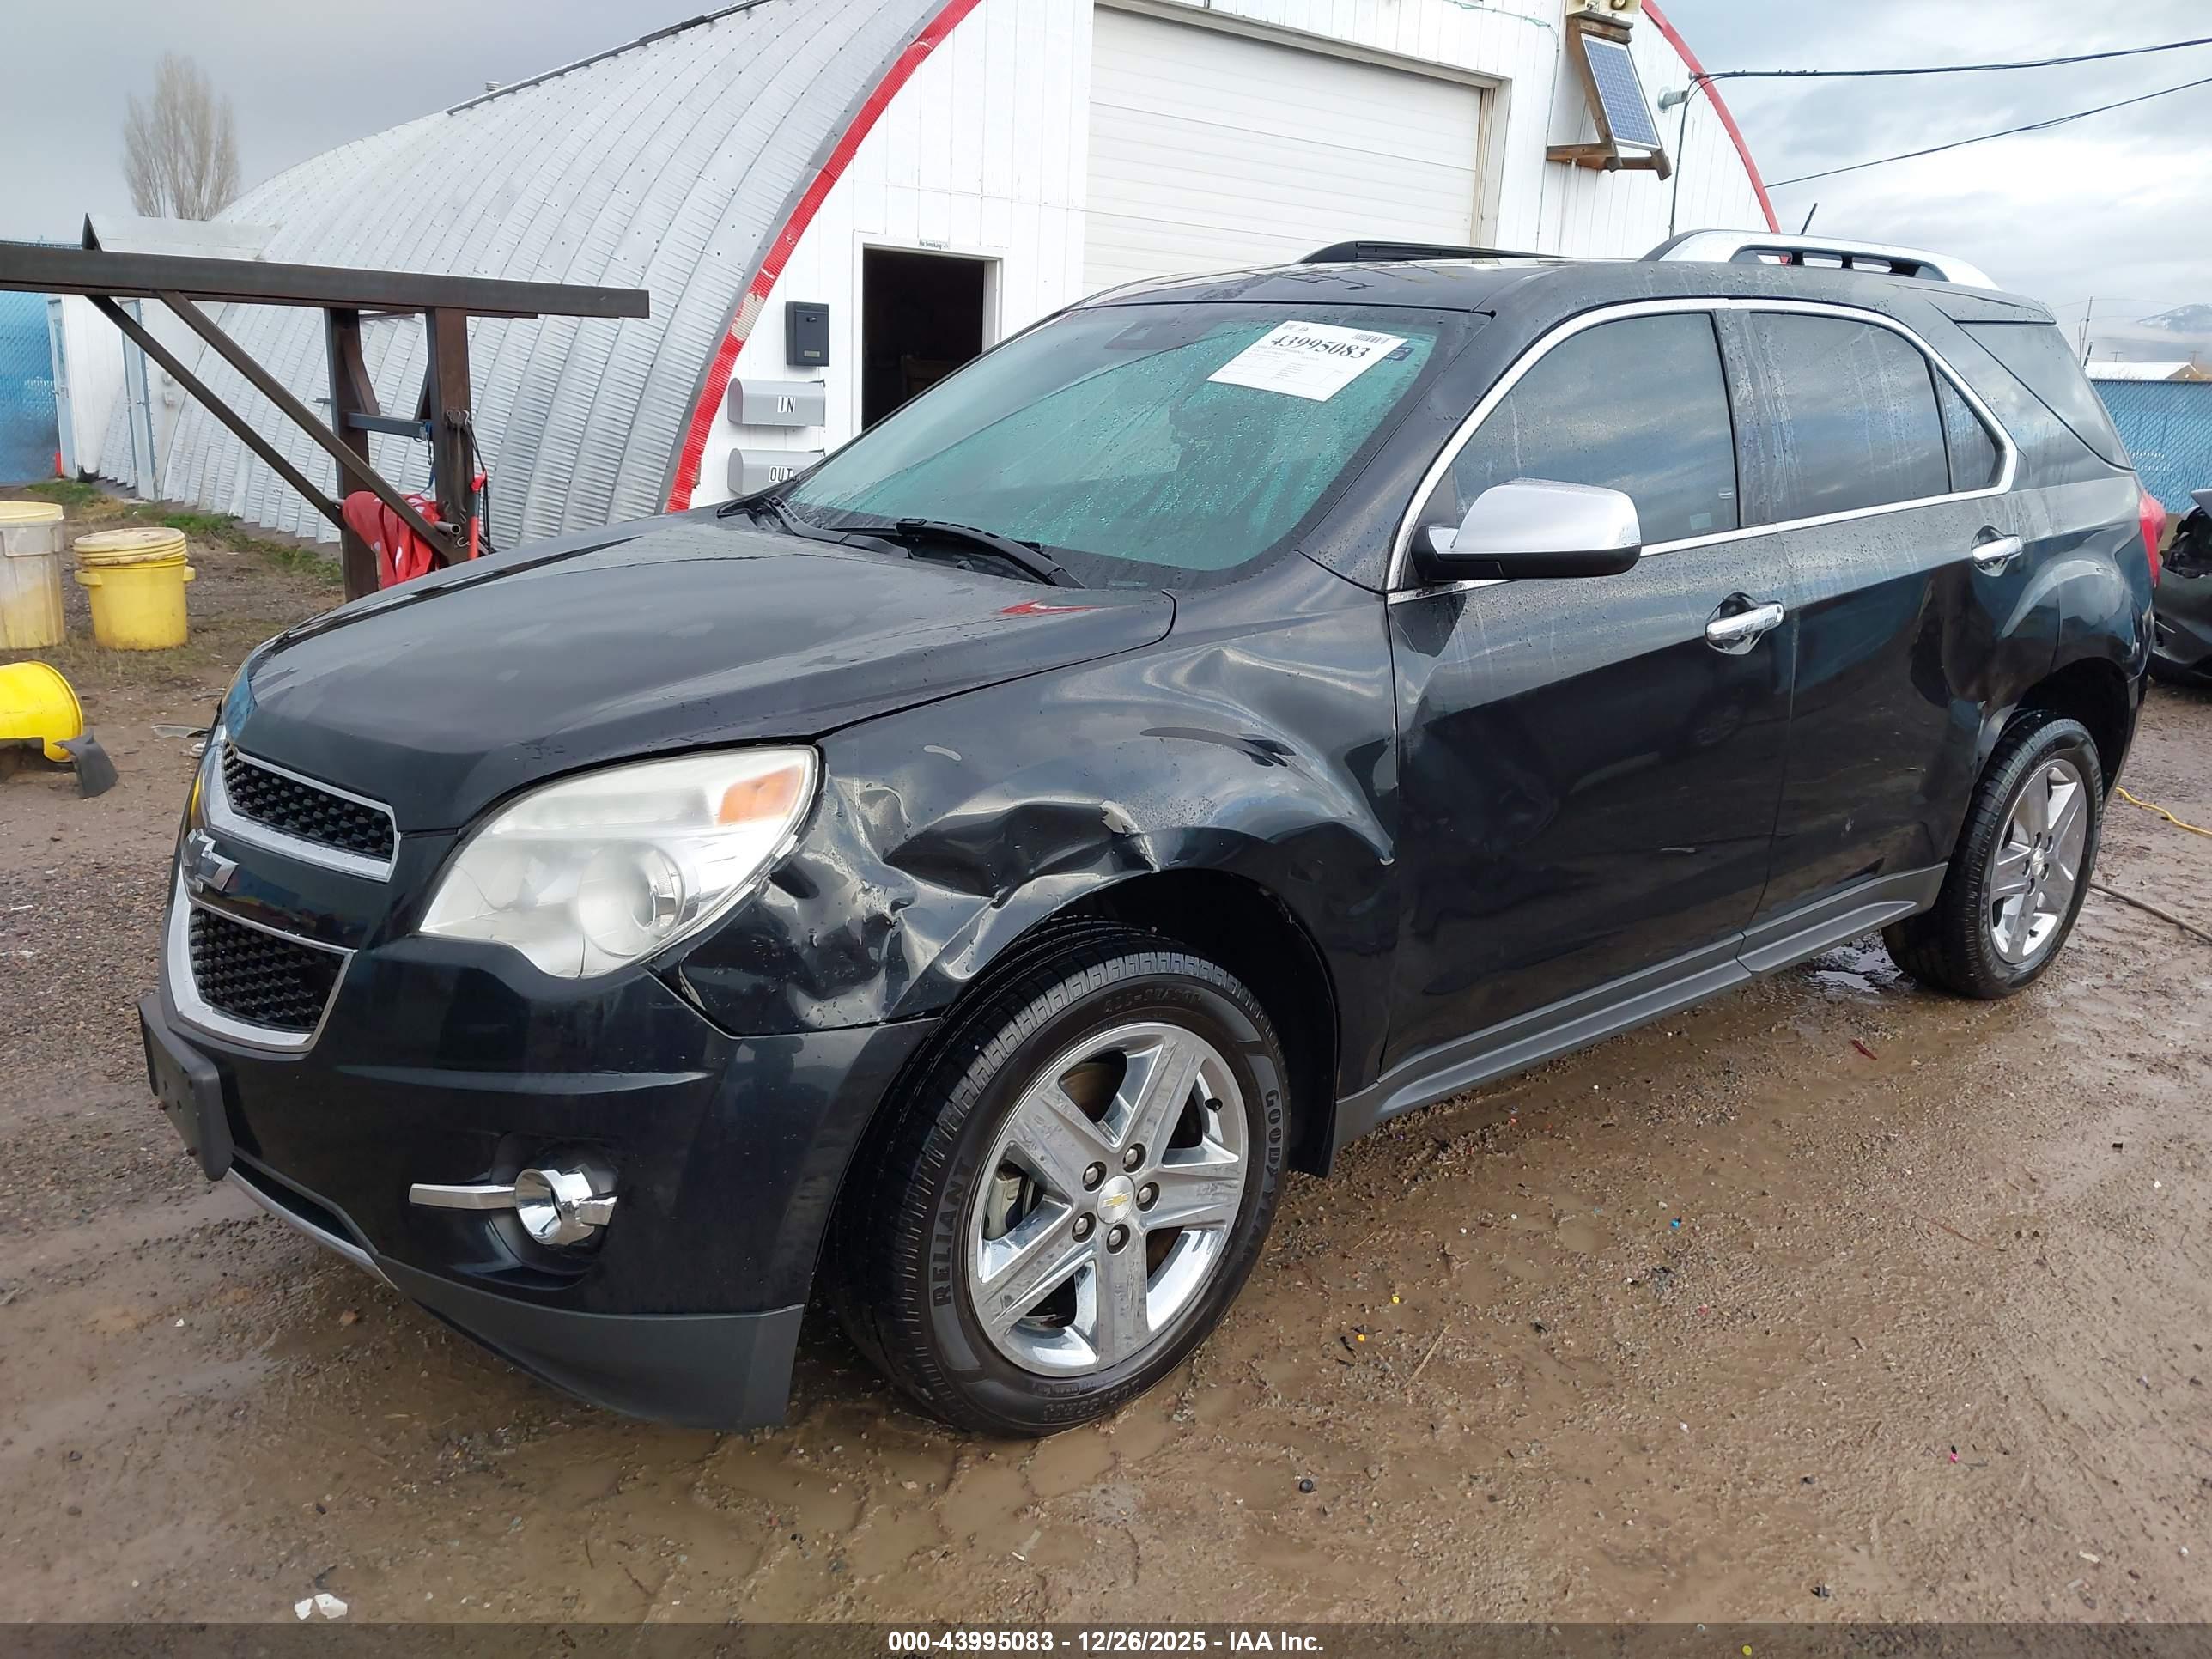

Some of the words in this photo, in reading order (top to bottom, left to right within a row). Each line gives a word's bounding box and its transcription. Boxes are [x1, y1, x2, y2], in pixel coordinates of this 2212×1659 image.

[1271, 335, 1371, 358] 43995083
[780, 397, 795, 412] IN
[769, 466, 793, 481] OUT
[933, 1156, 973, 1307] RELIANT
